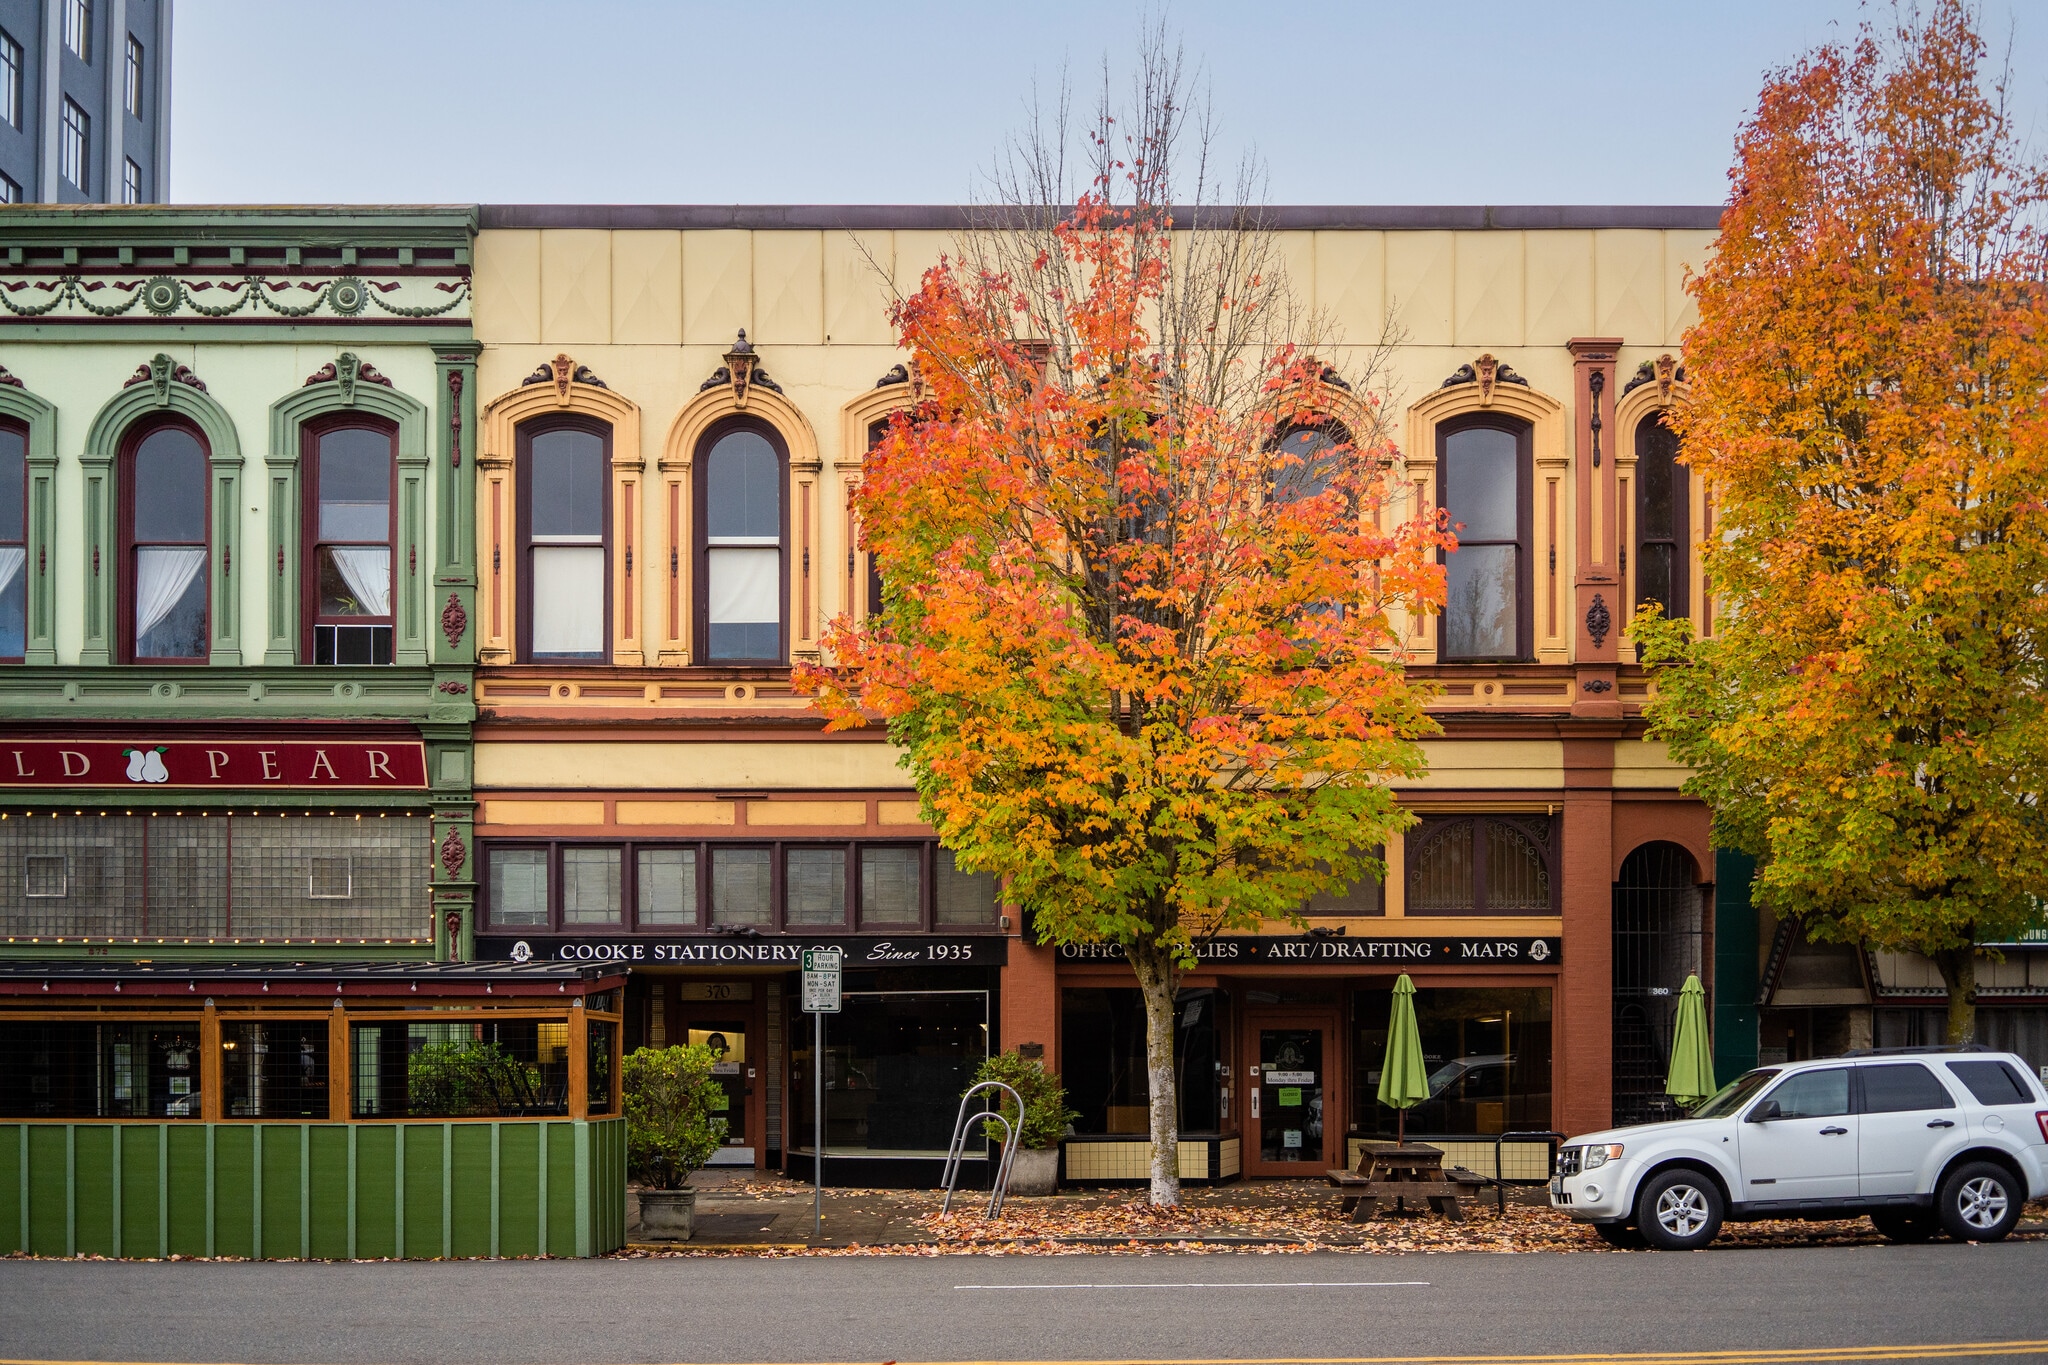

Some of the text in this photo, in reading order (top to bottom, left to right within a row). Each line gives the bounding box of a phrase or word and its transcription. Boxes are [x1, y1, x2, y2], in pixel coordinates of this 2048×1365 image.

[11, 750, 397, 780] LD PEAR
[2018, 929, 2047, 940] OUNG
[560, 944, 645, 960] COOKE
[654, 944, 802, 960] STATIONERY
[866, 942, 920, 960] Since
[927, 944, 972, 960] 1935
[1062, 943, 1127, 958] OFFIC
[1173, 943, 1239, 958] PLIES
[1267, 942, 1431, 959] ART/DRAFTING
[1461, 943, 1518, 958] MAPS
[806, 954, 812, 968] 3
[705, 985, 730, 999] 370
[1652, 987, 1669, 995] 360
